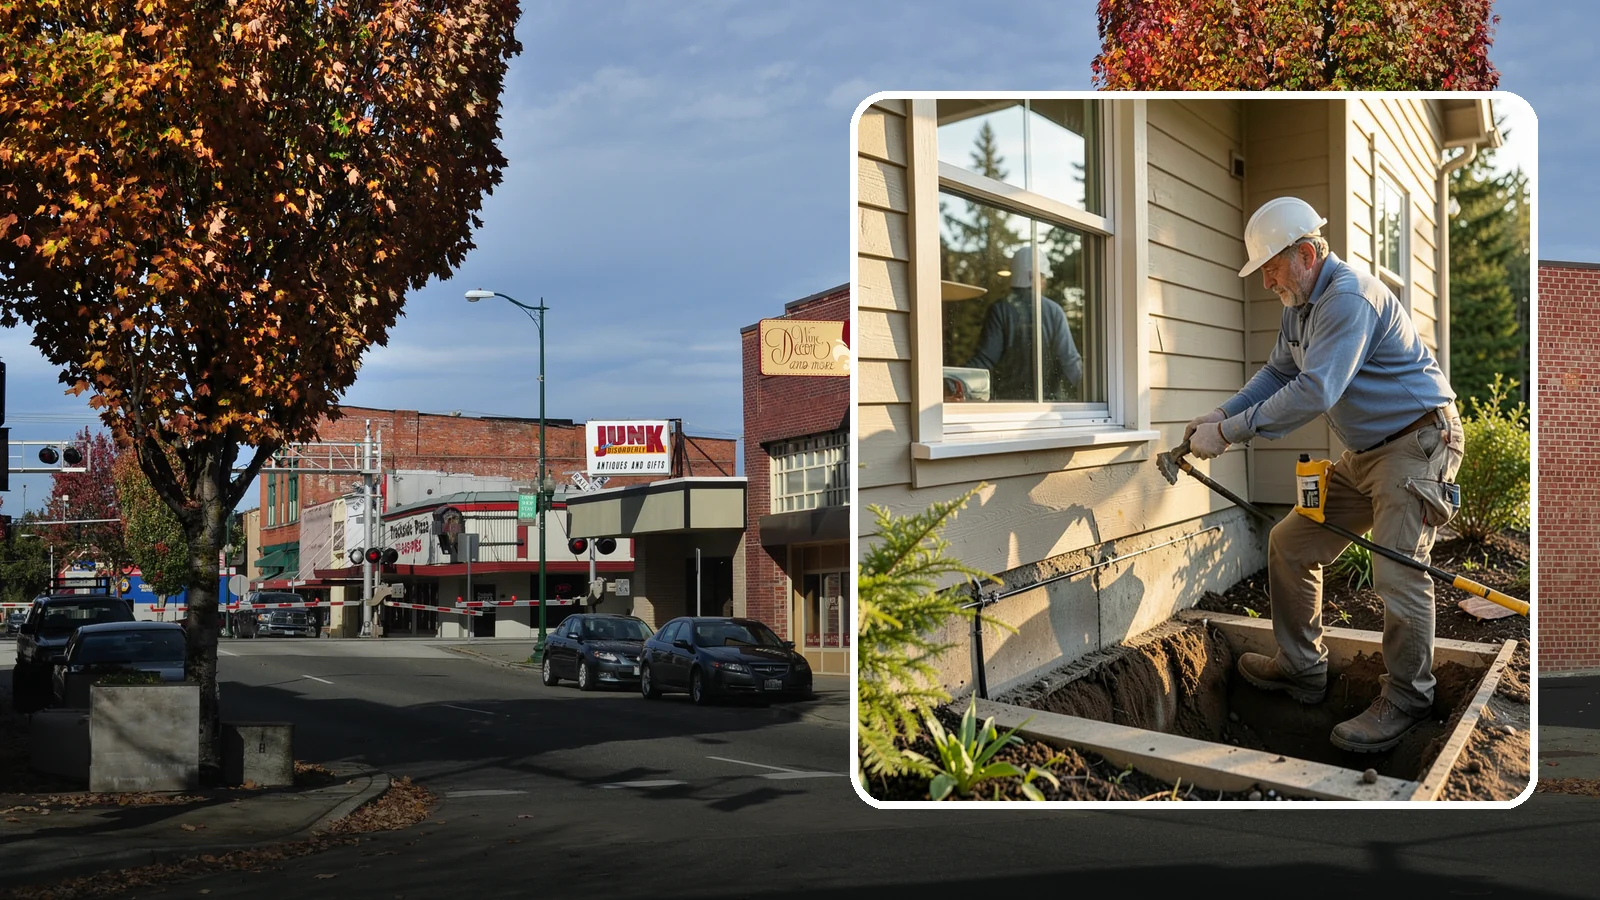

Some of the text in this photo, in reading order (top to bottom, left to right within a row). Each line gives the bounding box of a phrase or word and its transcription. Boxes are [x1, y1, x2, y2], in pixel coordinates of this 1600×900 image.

[595, 425, 666, 457] JUNK
[607, 446, 646, 454] DISORDERLY
[597, 460, 665, 470] ANTIQUES AND GIFTS
[573, 473, 589, 492] RAIL
[353, 498, 364, 511] CRO
[414, 519, 429, 535] Pizza
